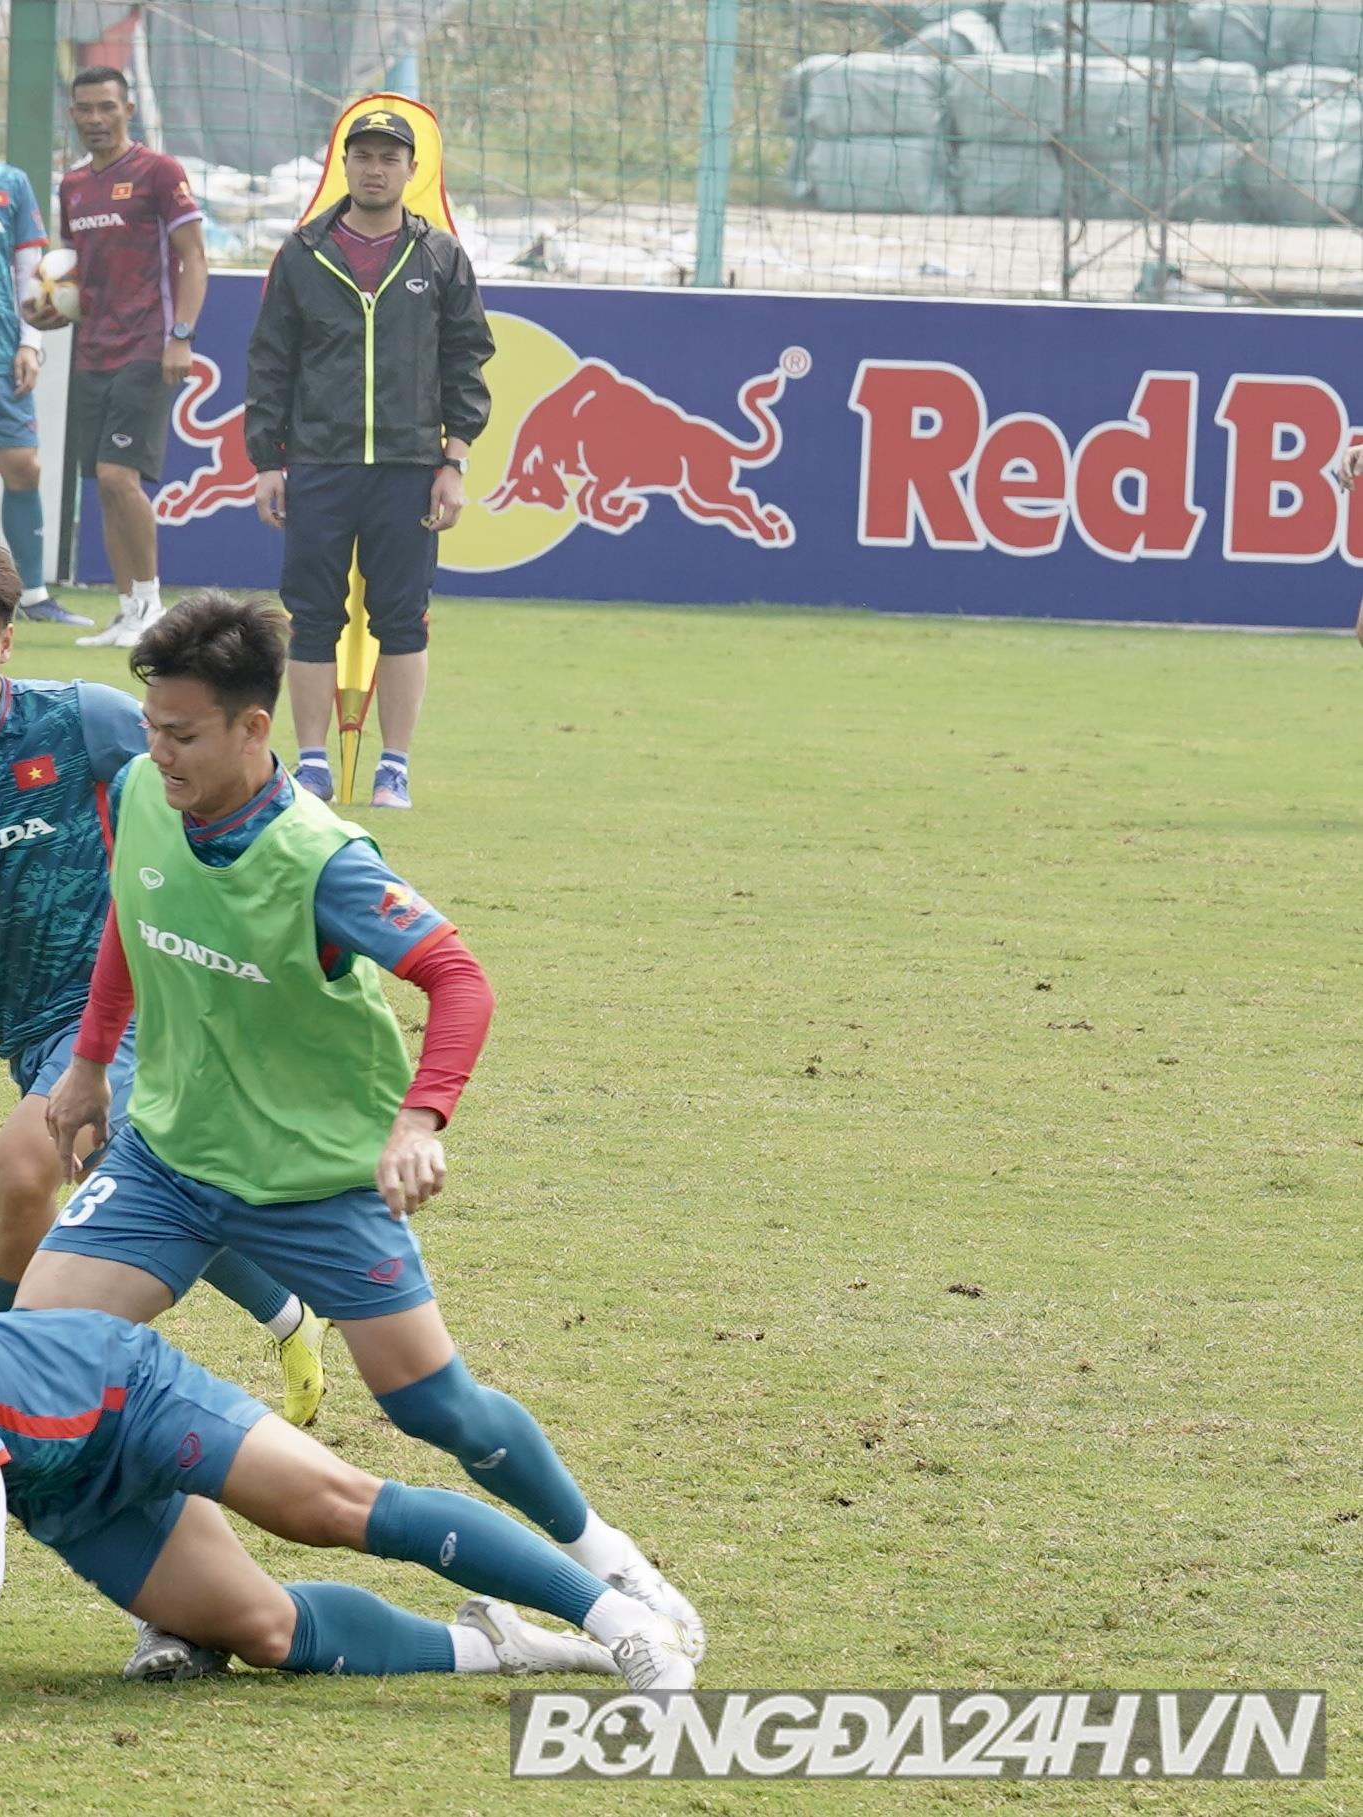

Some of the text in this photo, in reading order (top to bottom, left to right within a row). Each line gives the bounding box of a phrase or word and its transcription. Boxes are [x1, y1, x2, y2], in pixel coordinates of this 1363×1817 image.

[68, 212, 125, 232] HONDA
[848, 358, 1363, 567] Red B
[137, 919, 271, 984] HONDA
